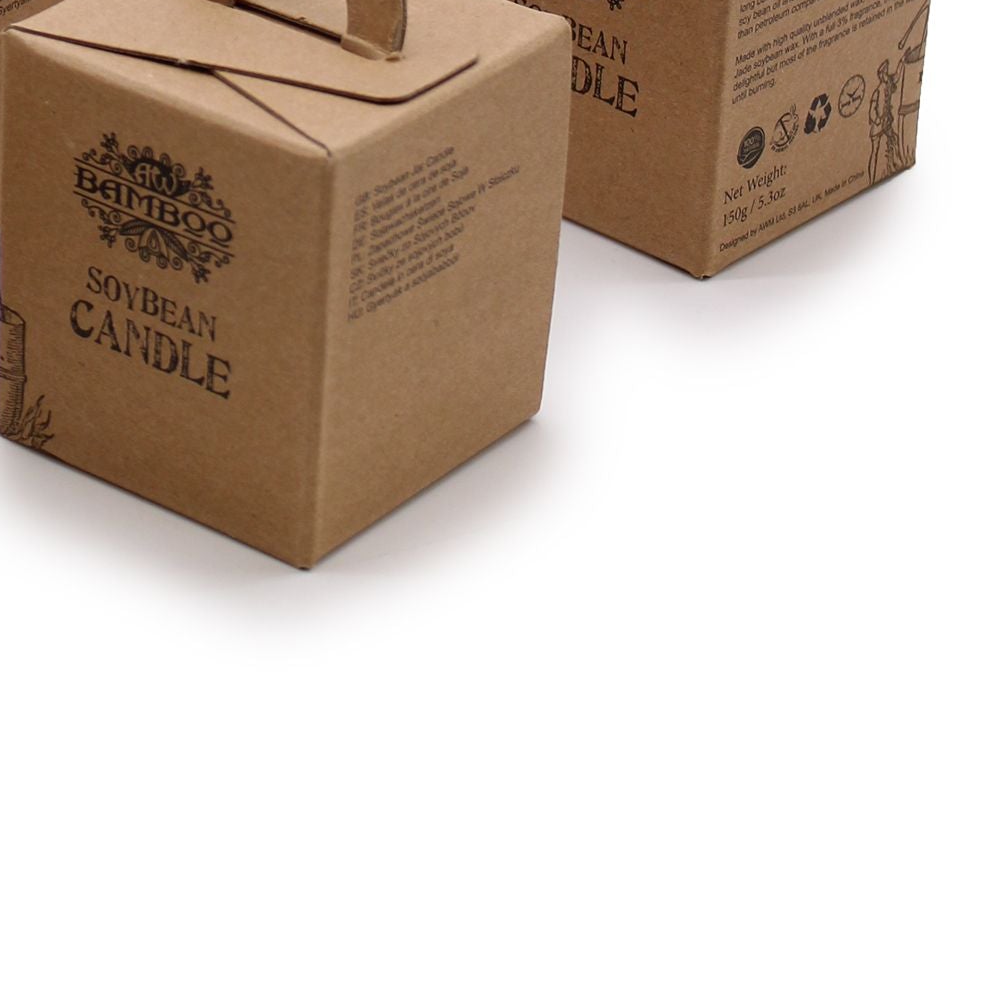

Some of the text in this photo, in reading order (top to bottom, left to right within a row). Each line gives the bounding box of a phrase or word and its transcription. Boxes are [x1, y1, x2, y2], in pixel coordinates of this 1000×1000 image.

[735, 50, 755, 65] Made
[756, 41, 771, 55] with
[772, 33, 787, 47] high
[789, 23, 811, 41] quality
[813, 3, 848, 27] unblended
[737, 26, 753, 39] than
[754, 9, 789, 33] petroleum
[738, 14, 750, 26] soy
[752, 5, 770, 19] bean
[739, 0, 755, 13] long
[733, 69, 764, 91] delightful
[766, 62, 777, 75] but
[779, 53, 796, 69] most
[797, 49, 804, 60] of
[805, 45, 816, 55] the
[818, 28, 850, 49] fragrance
[851, 24, 857, 32] is
[858, 8, 885, 29] retained
[886, 6, 892, 14] in
[894, 0, 904, 10] the
[734, 64, 751, 78] Jade
[753, 49, 782, 69] soybean
[802, 31, 817, 45] With
[825, 22, 835, 34] full
[571, 56, 640, 118] DLE
[731, 90, 746, 104] until
[73, 165, 233, 248] BAMBOO
[722, 202, 747, 231] 150g
[758, 184, 786, 210] 5.3oz
[723, 160, 787, 205] Net Weight:
[86, 266, 217, 342] SOYBEAN
[70, 300, 232, 400] CANDLE
